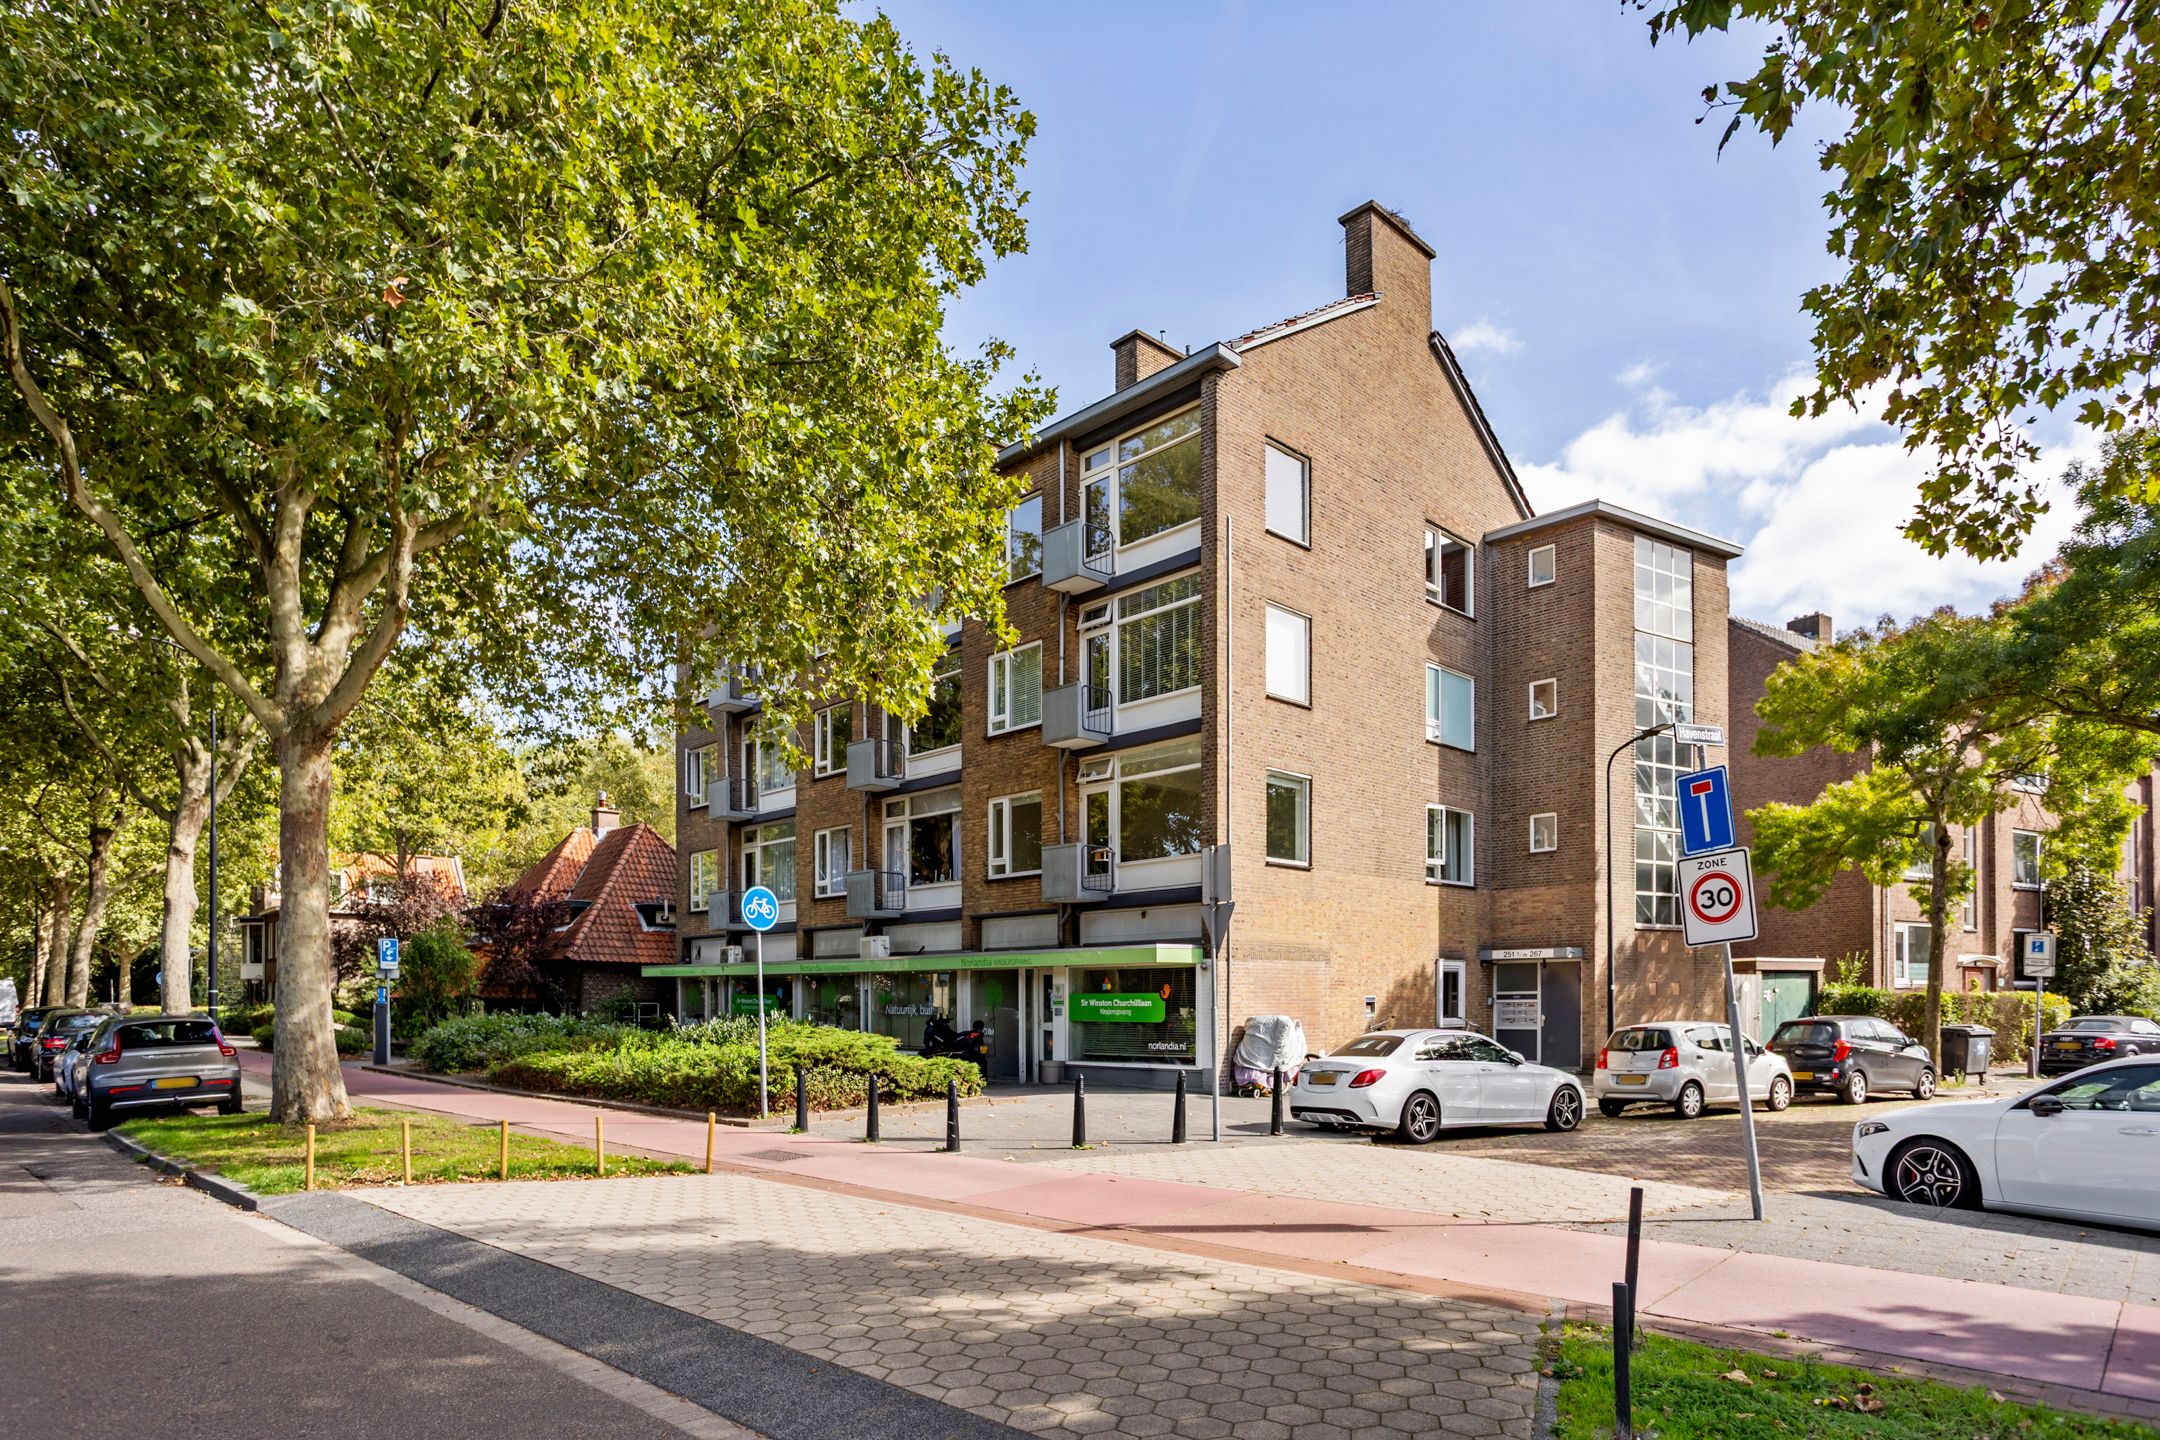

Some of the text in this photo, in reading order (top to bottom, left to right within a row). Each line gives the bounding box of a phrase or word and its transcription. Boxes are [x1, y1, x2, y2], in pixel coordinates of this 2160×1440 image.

[1679, 726, 1722, 741] Havenstraat
[1697, 858, 1727, 870] ZONE
[1700, 887, 1733, 909] 30
[383, 940, 391, 951] P
[960, 958, 992, 967] Norlandia
[1080, 999, 1089, 1007] Sir
[1089, 999, 1113, 1007] Winston
[885, 1004, 918, 1016] Natuurlijk,
[1100, 1008, 1132, 1016] Kinderopvang
[1148, 1042, 1187, 1051] norlandia.nl
